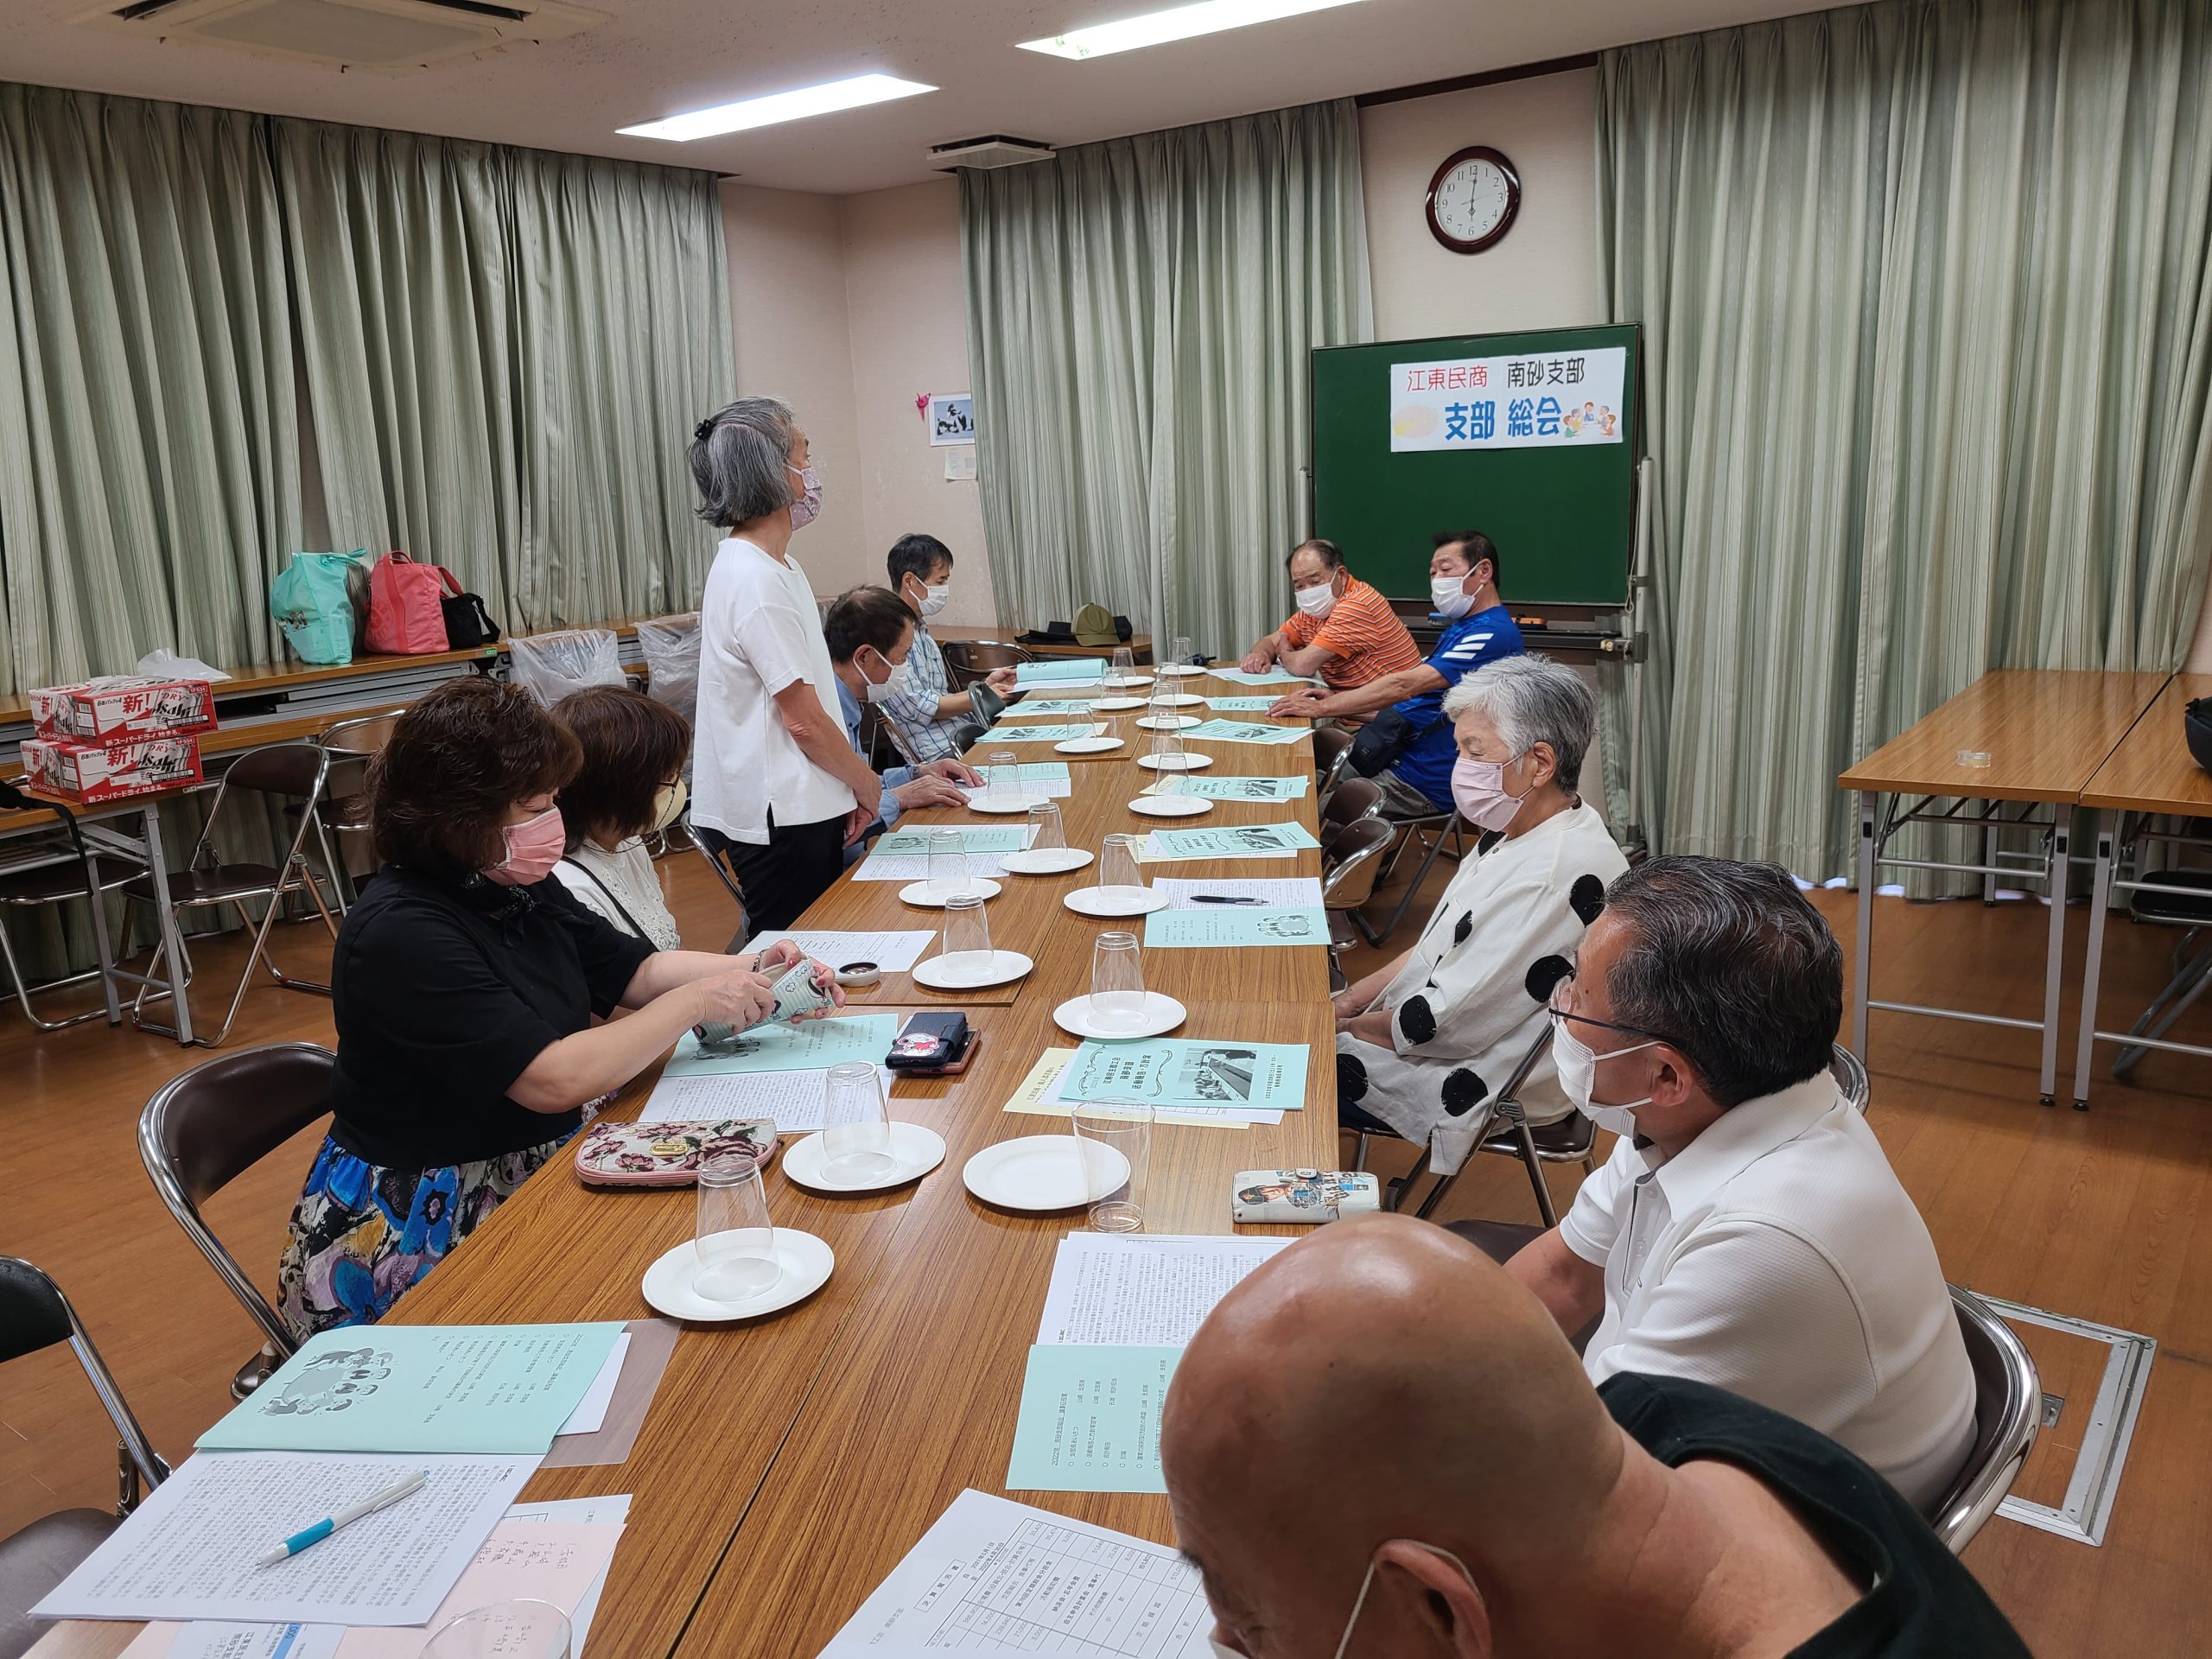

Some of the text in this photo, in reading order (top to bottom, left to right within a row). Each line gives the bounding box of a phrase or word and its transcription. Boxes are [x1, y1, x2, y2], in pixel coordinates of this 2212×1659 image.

[1407, 358, 1585, 391] 江東民商 南砂支部
[1445, 397, 1561, 441] 支部 総会
[161, 692, 185, 702] DRY
[152, 700, 191, 718] Asahi
[148, 744, 171, 753] DRY
